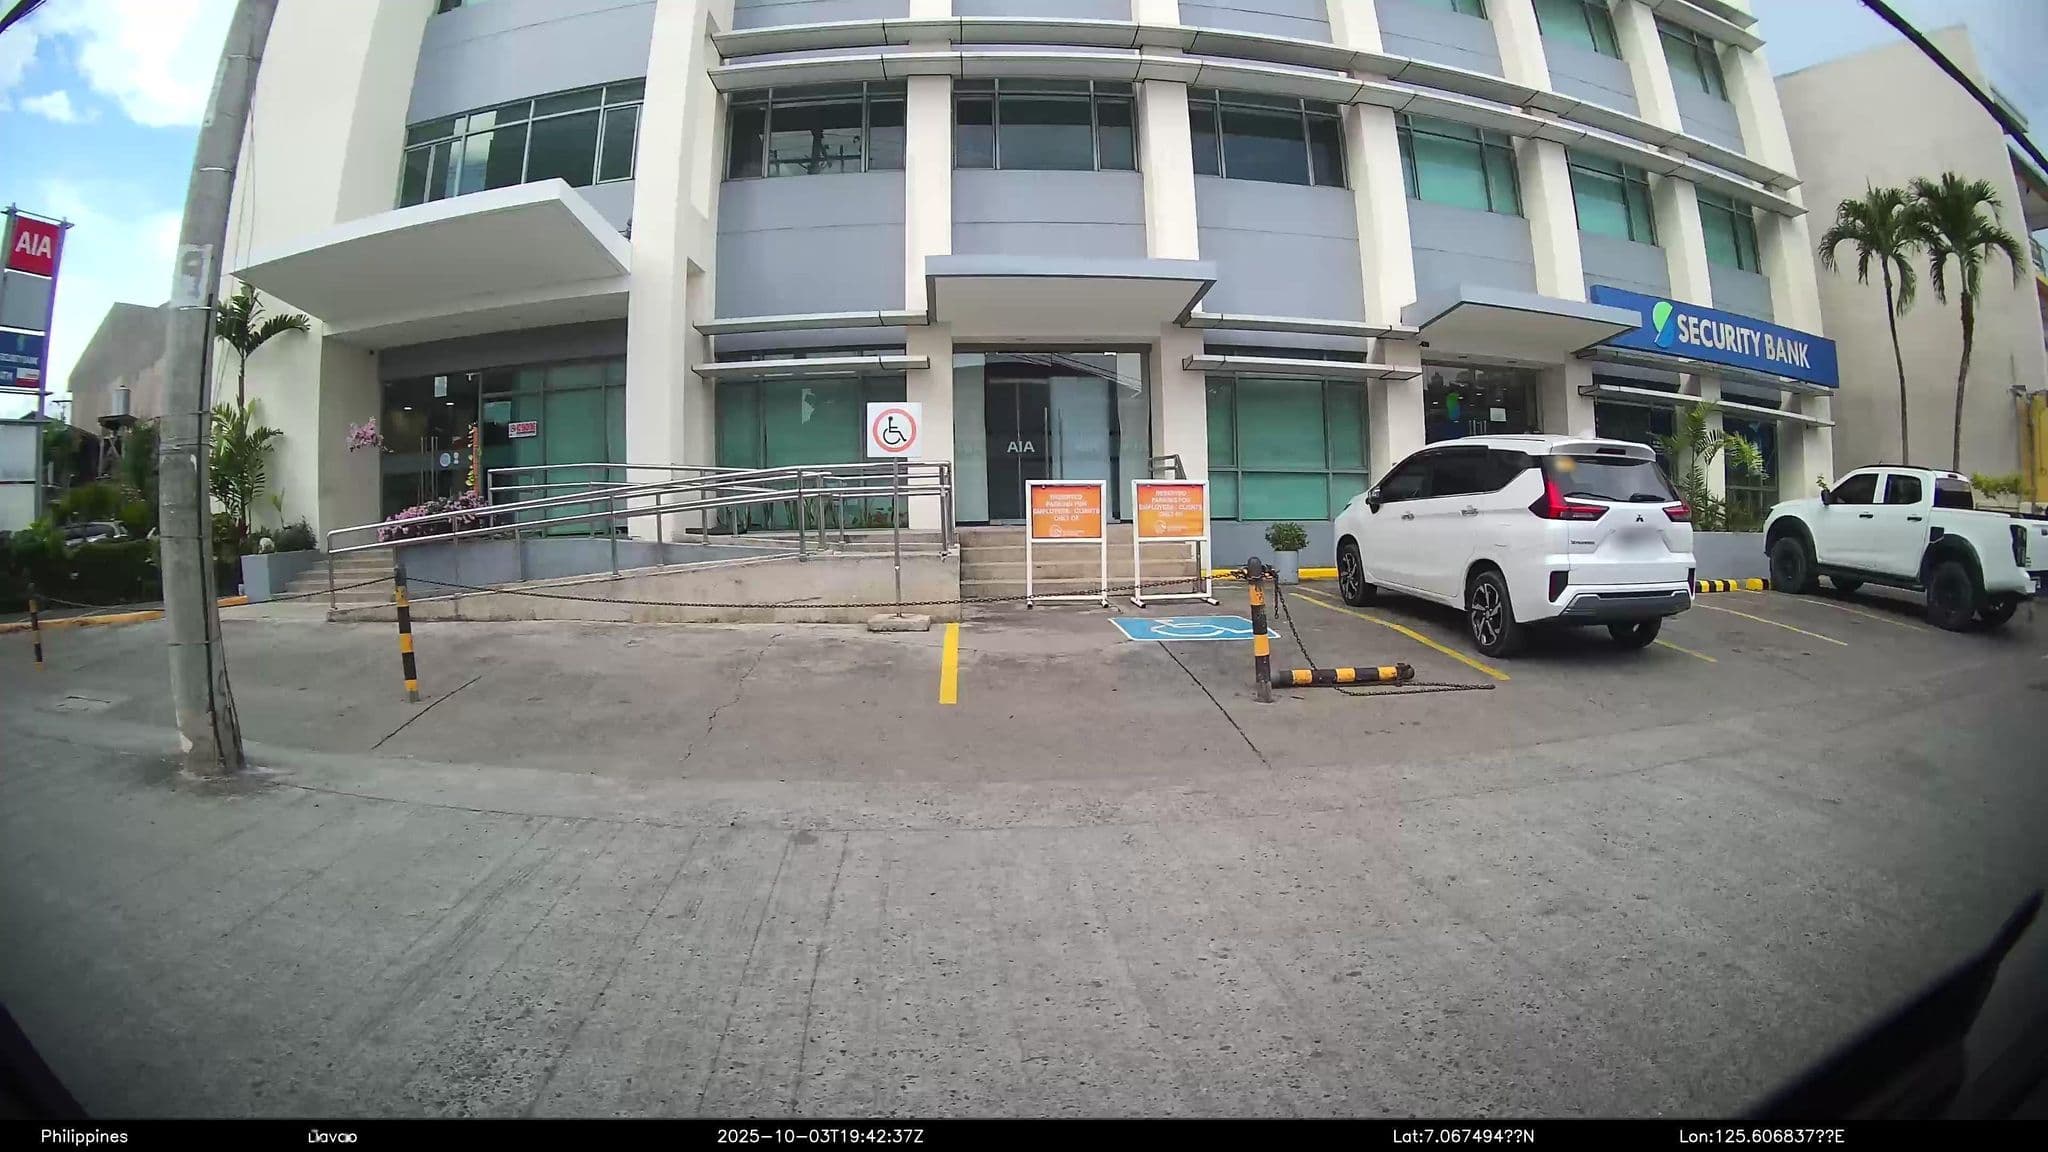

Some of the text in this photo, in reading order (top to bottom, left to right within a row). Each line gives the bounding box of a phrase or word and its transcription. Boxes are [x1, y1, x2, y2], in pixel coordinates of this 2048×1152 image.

[15, 231, 52, 259] AIA
[1677, 313, 1812, 369] SECURITY BANK
[1007, 440, 1035, 453] AIA
